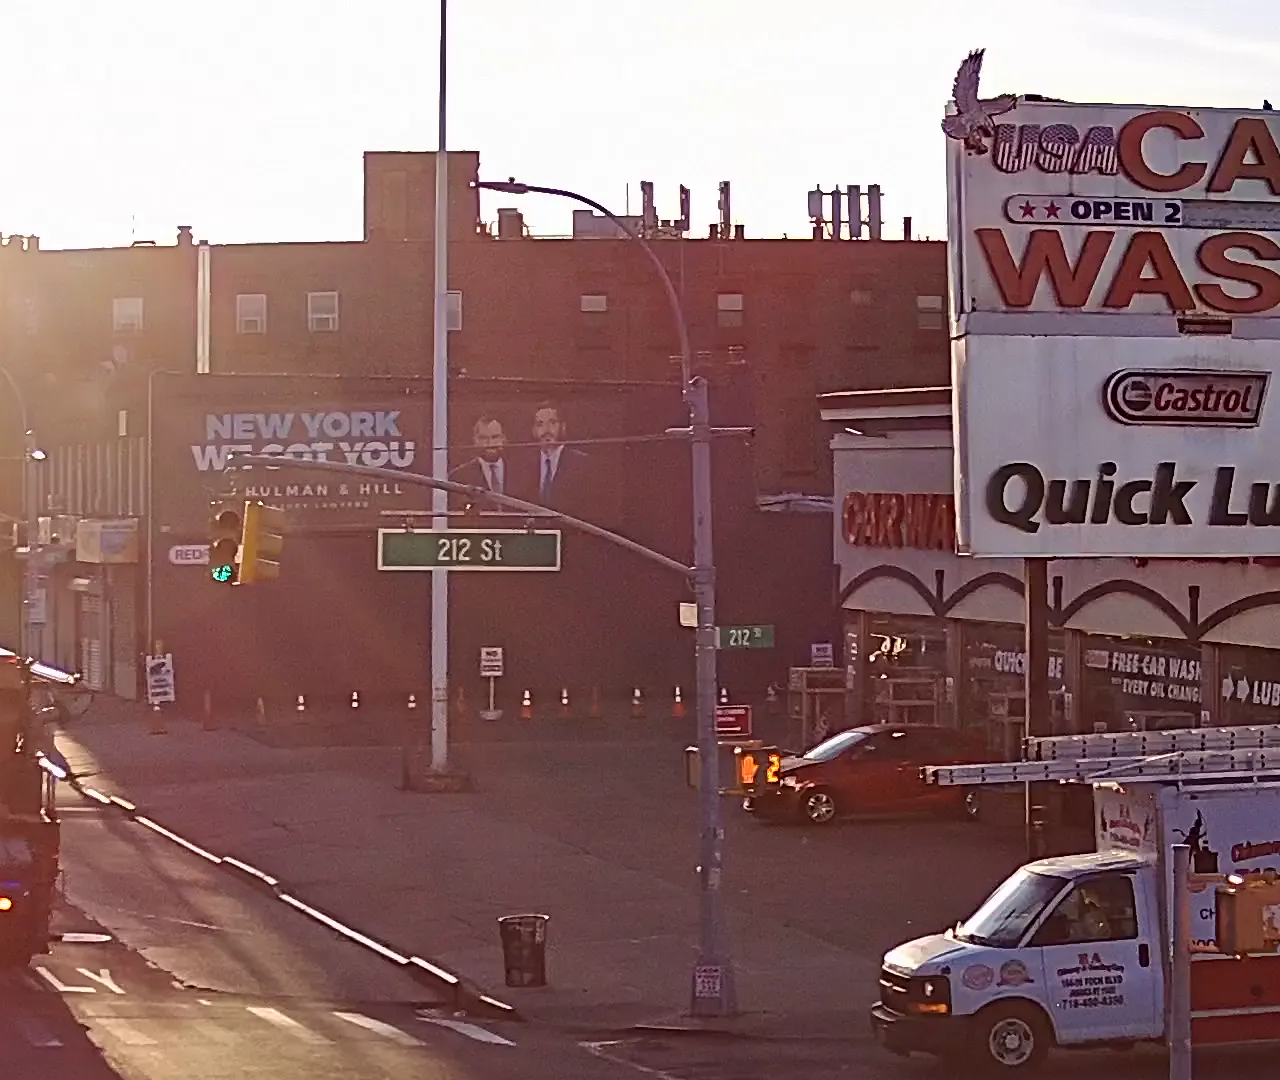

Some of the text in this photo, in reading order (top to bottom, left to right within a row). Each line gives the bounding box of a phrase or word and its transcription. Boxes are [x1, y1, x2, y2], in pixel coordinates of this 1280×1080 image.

[992, 123, 1119, 175] USA
[1070, 199, 1181, 223] OPEN 2
[1153, 382, 1251, 414] Castrol
[206, 410, 401, 440] NEW YORK
[260, 442, 337, 469] GOT
[341, 441, 415, 468] YOU
[359, 483, 404, 495] HILL
[987, 461, 1198, 534] Quick
[437, 538, 503, 562] 212 St
[729, 630, 751, 646] 212
[1111, 651, 1139, 674] FREE
[1142, 655, 1166, 677] CAR
[1122, 678, 1149, 696] EVERY
[1150, 681, 1165, 698] OIL
[766, 753, 781, 783] 2
